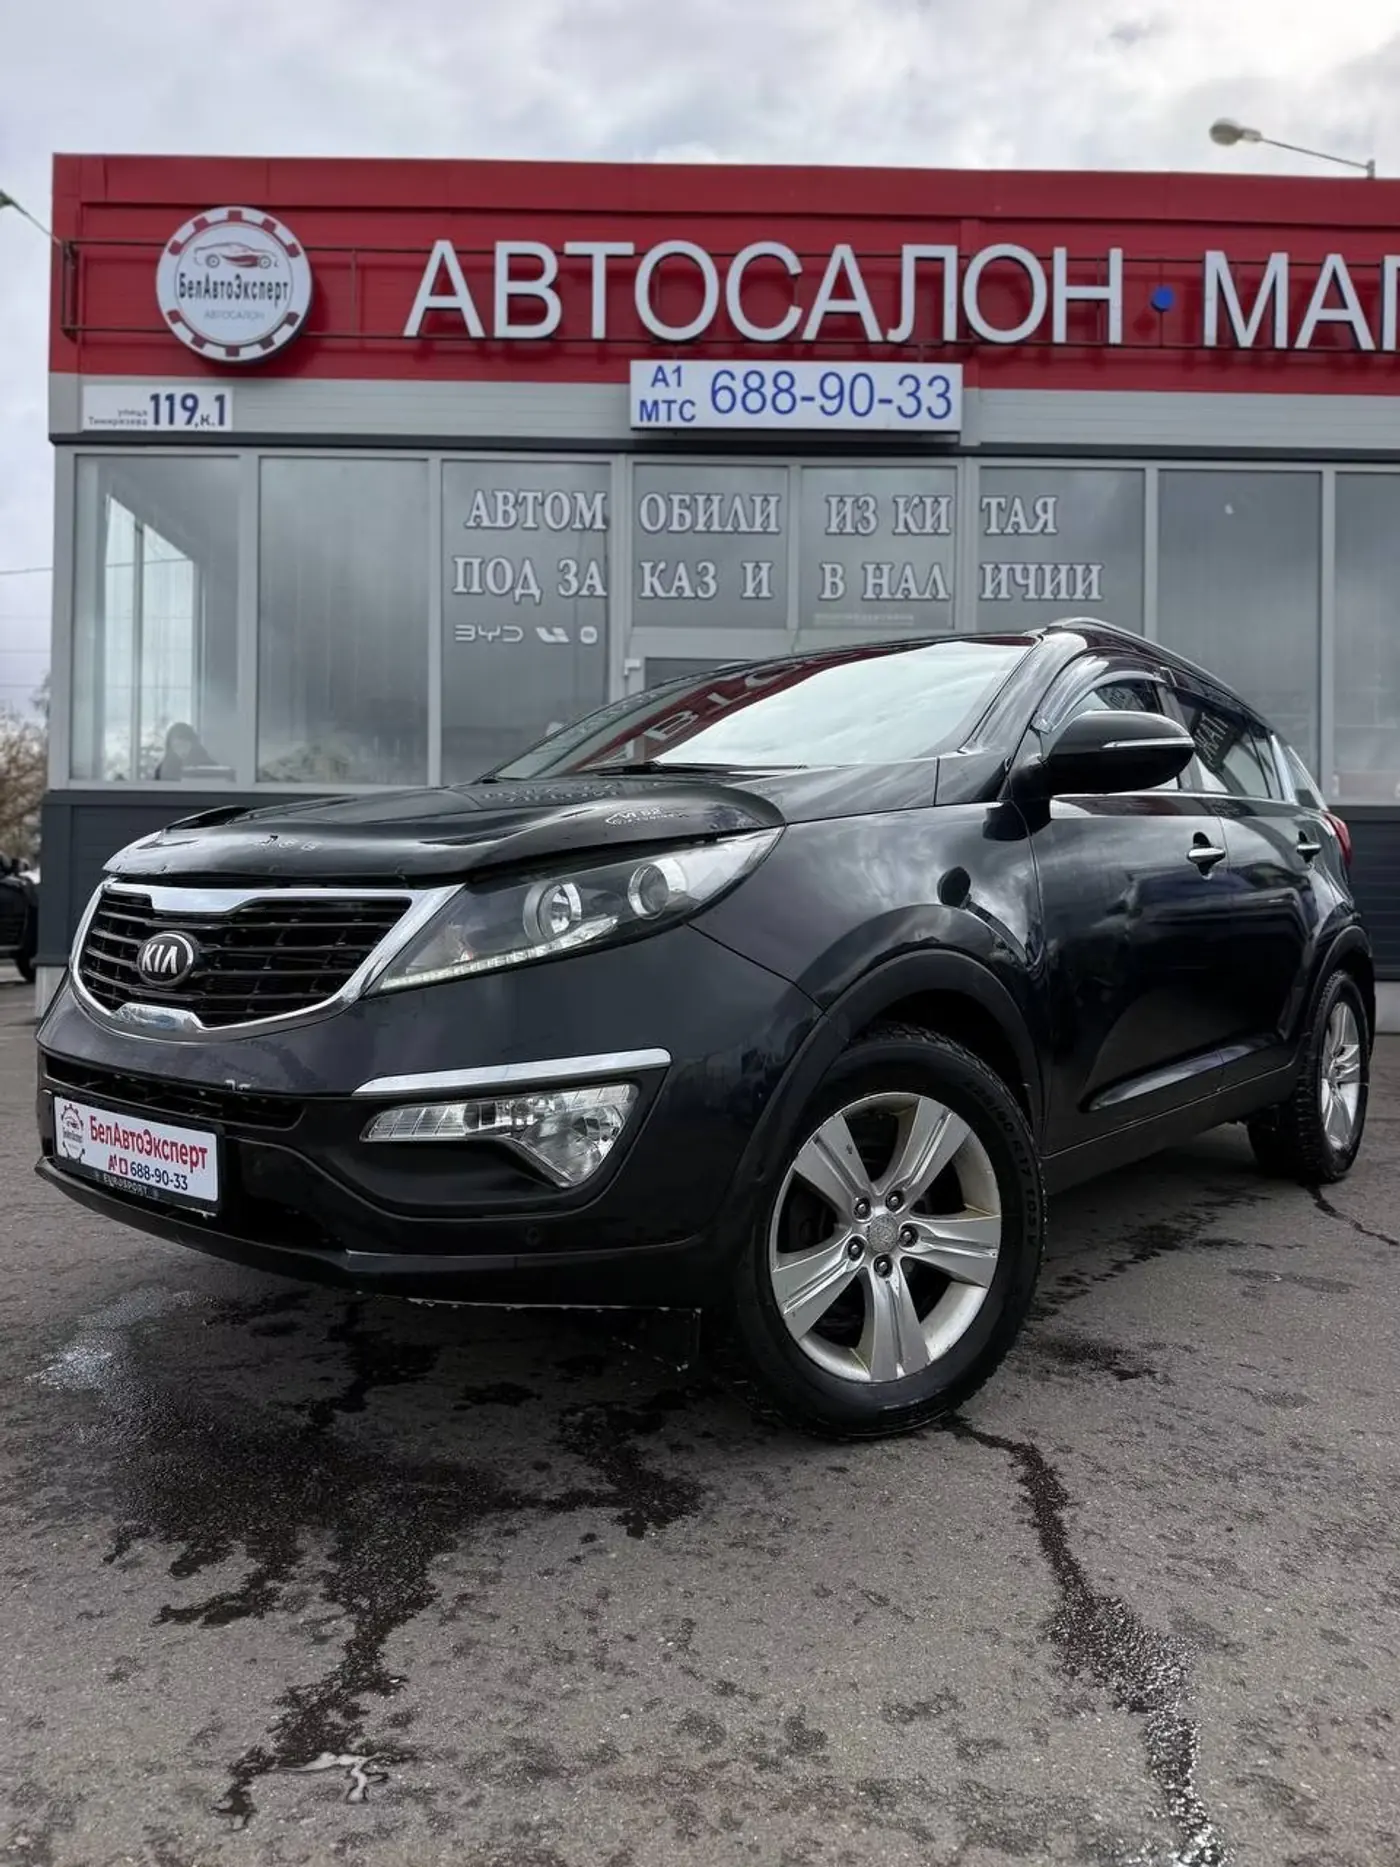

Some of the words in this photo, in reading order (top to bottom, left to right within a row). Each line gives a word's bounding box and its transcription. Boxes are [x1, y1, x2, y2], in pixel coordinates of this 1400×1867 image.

[179, 273, 289, 309] БелАвтоЭксперт
[402, 239, 1123, 344] АВТОСАЛОН
[639, 400, 696, 423] МТС
[710, 369, 952, 420] 688-90-33
[826, 495, 877, 534] ИЗ
[453, 557, 541, 603] ПОД
[742, 562, 772, 598] И
[819, 562, 845, 600] В
[455, 624, 524, 642] BYD
[142, 944, 178, 974] KIA
[89, 1115, 208, 1173] БелАвтоЭксперт
[130, 1161, 188, 1191] 688-90-33
